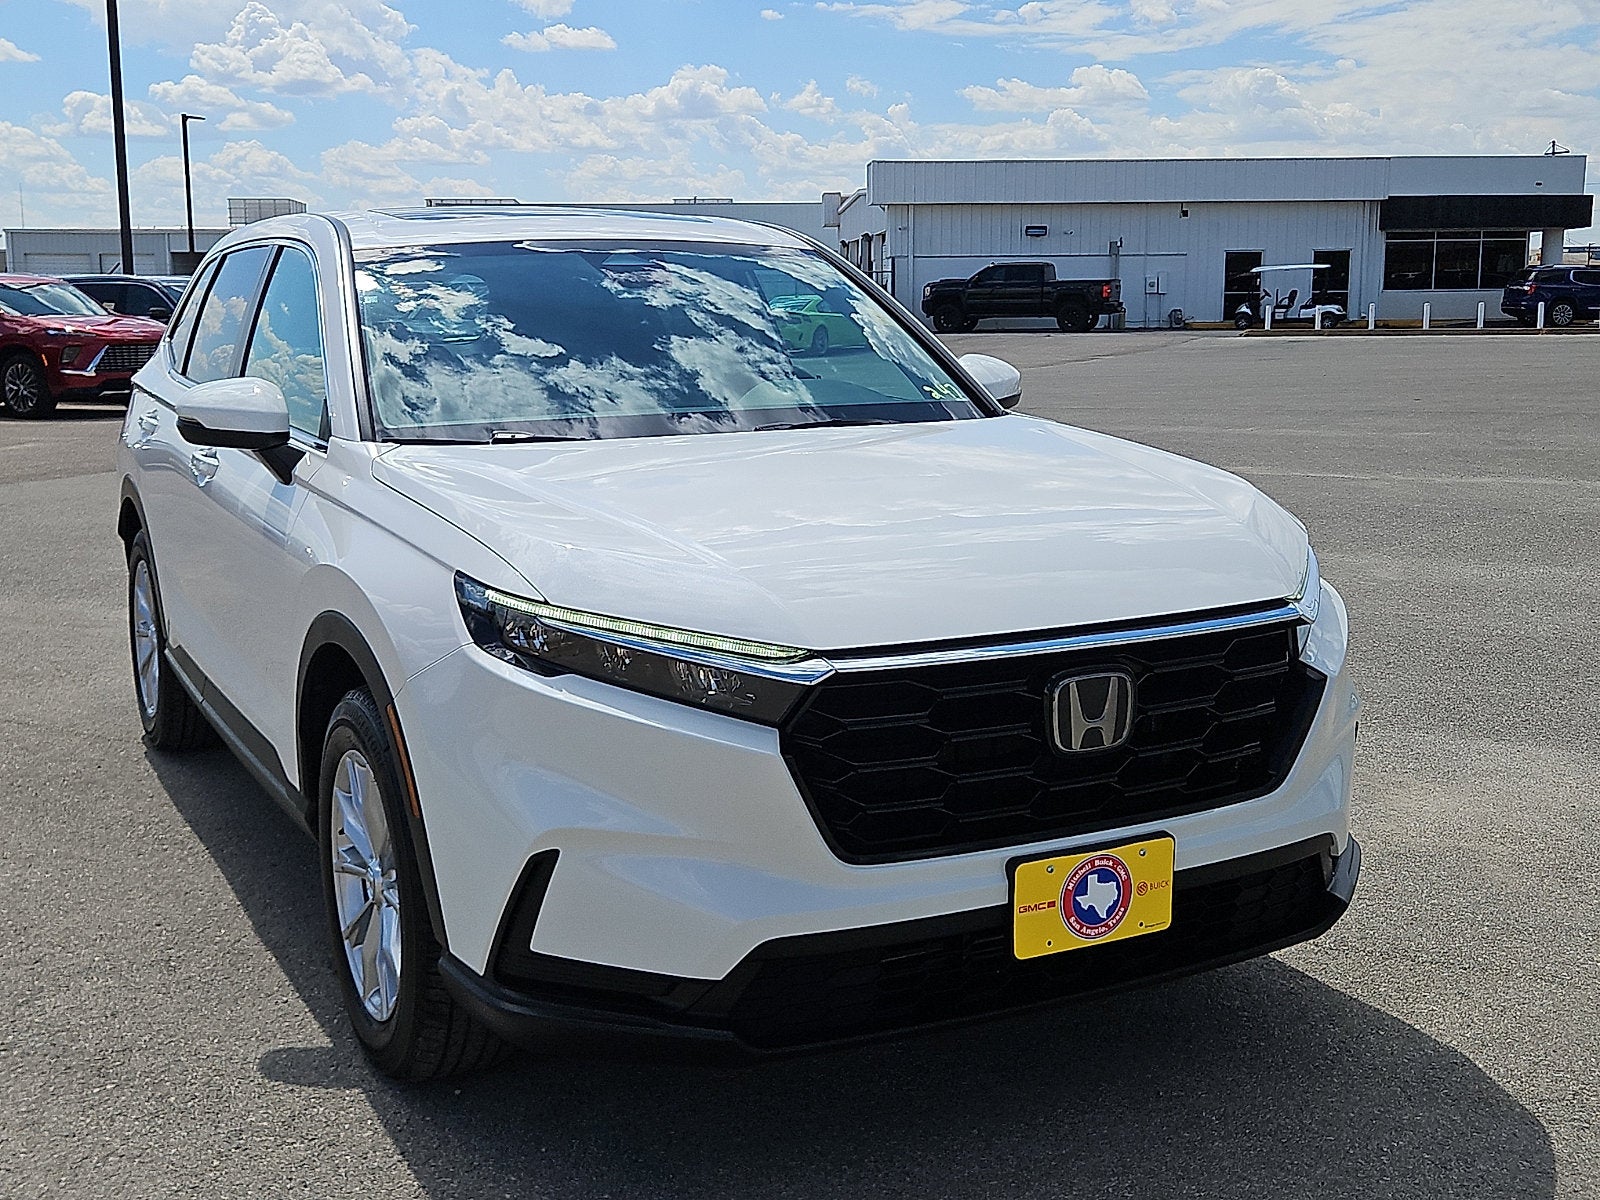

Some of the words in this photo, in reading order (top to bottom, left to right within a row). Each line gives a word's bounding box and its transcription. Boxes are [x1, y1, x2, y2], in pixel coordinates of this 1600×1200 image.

[1067, 862, 1092, 891] Mitchell
[1149, 879, 1170, 891] BUICK
[1018, 902, 1047, 914] GMC
[1069, 916, 1081, 931] San
